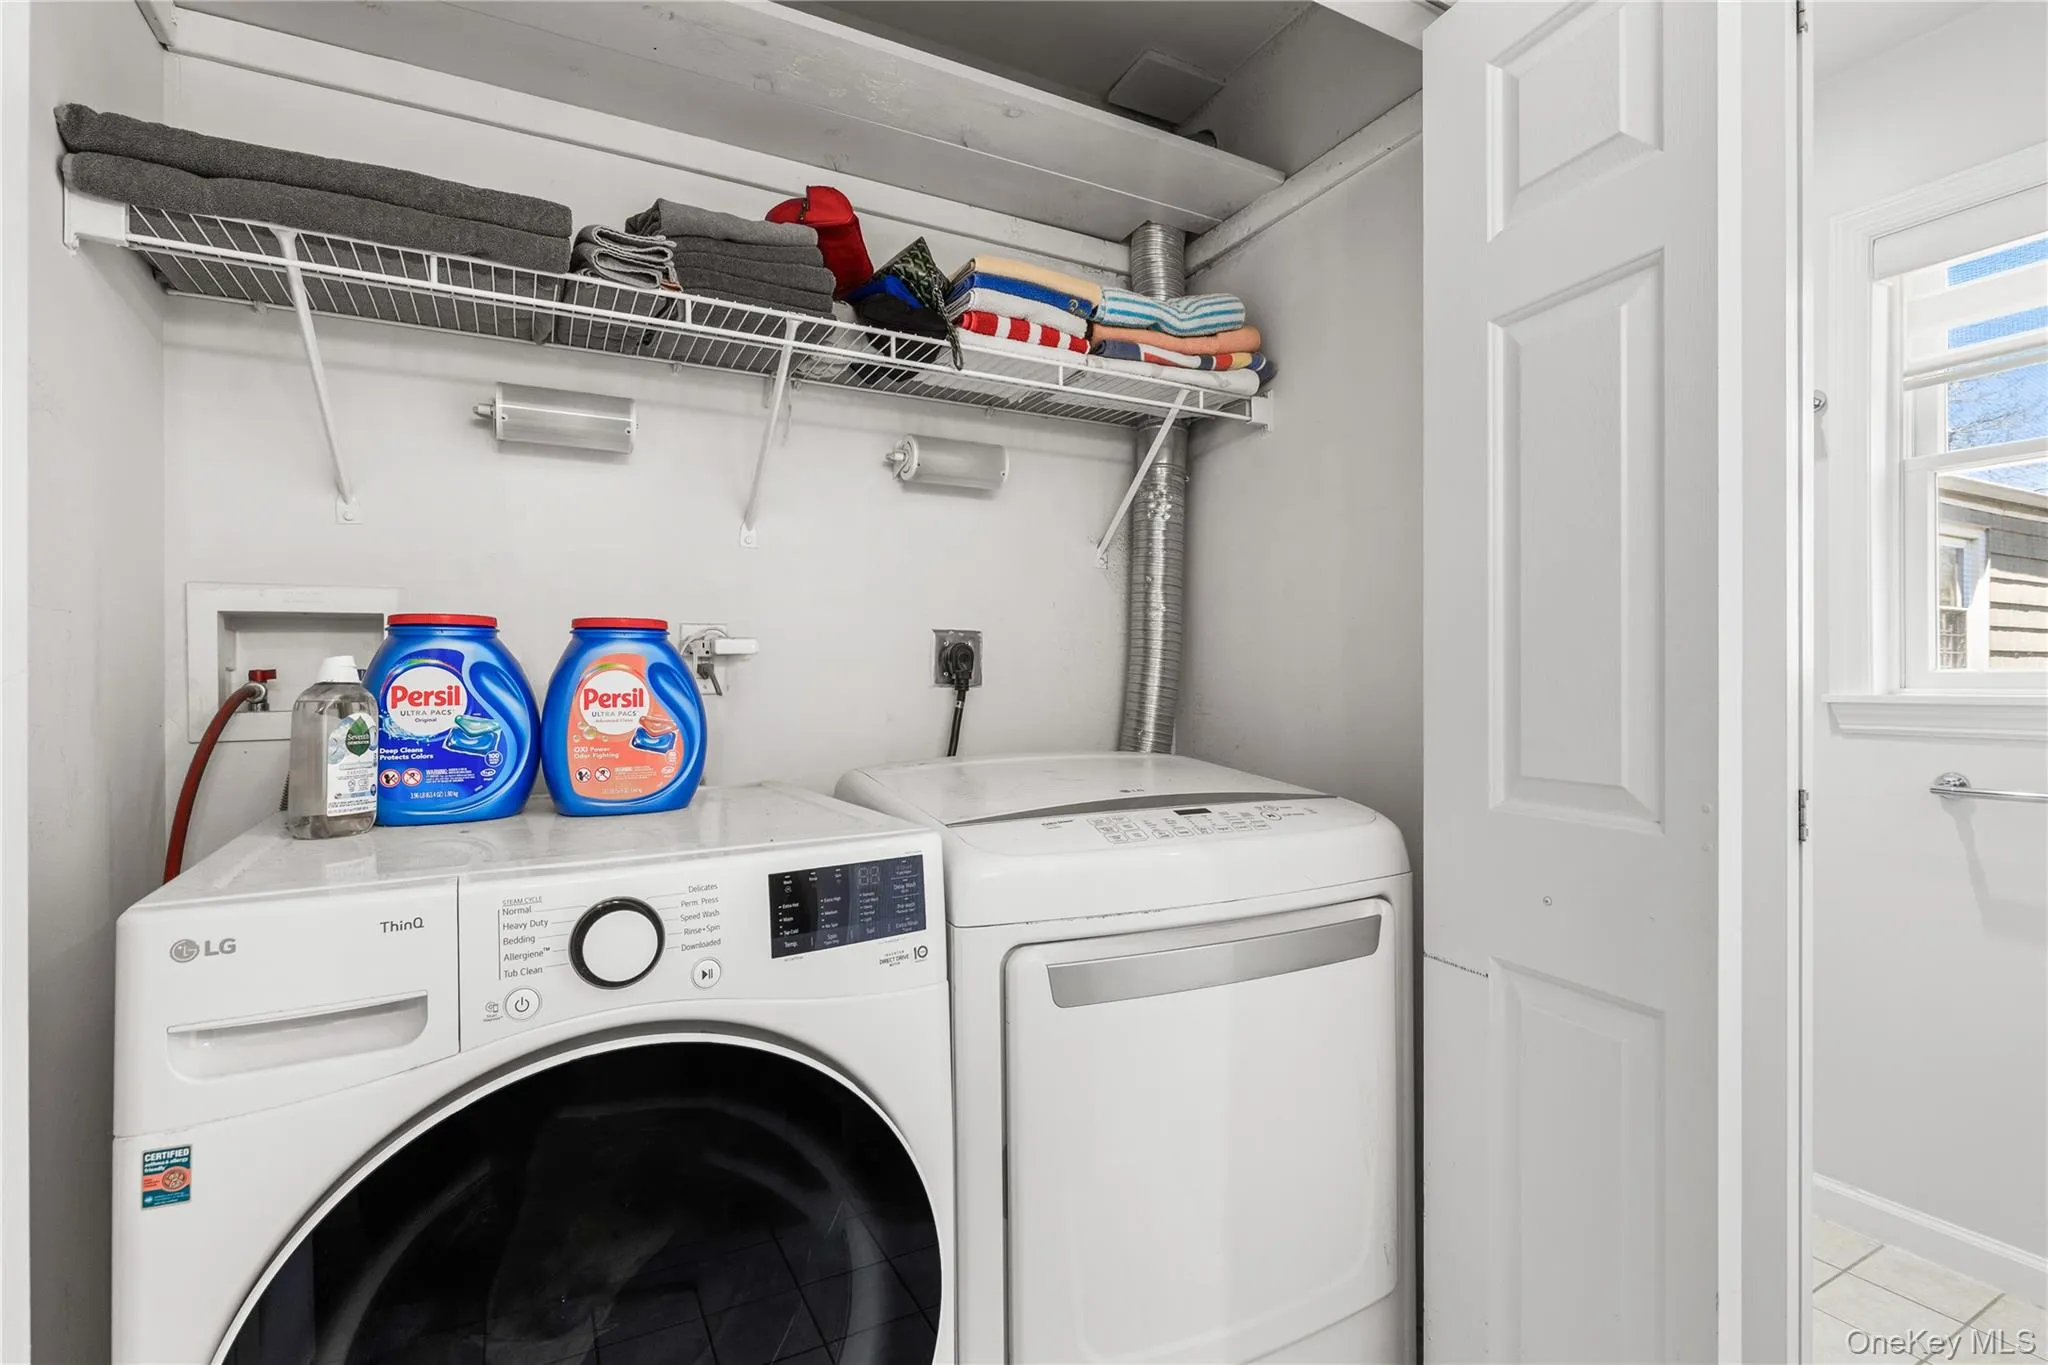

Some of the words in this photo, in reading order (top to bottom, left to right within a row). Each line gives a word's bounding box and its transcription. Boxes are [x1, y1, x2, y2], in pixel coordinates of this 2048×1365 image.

[391, 685, 461, 709] Persil
[584, 688, 643, 711] Persil
[688, 884, 718, 893] Delicates
[502, 898, 523, 906] STEAM
[524, 896, 542, 904] CYCLE
[701, 897, 719, 905] Press
[502, 906, 532, 915] Normal
[680, 912, 701, 922] Speed
[702, 909, 720, 918] Wash
[380, 917, 424, 933] ThinQ
[503, 922, 527, 931] Heavy
[530, 919, 549, 928] Duty
[503, 935, 536, 946] Bedding
[681, 938, 721, 952] Downloaded
[204, 937, 236, 957] LG
[879, 956, 895, 965] DIRECT
[896, 953, 909, 961] DRIVE
[504, 969, 518, 978] Tub
[520, 967, 543, 976] Clean
[144, 1148, 190, 1162] CERTIFIED
